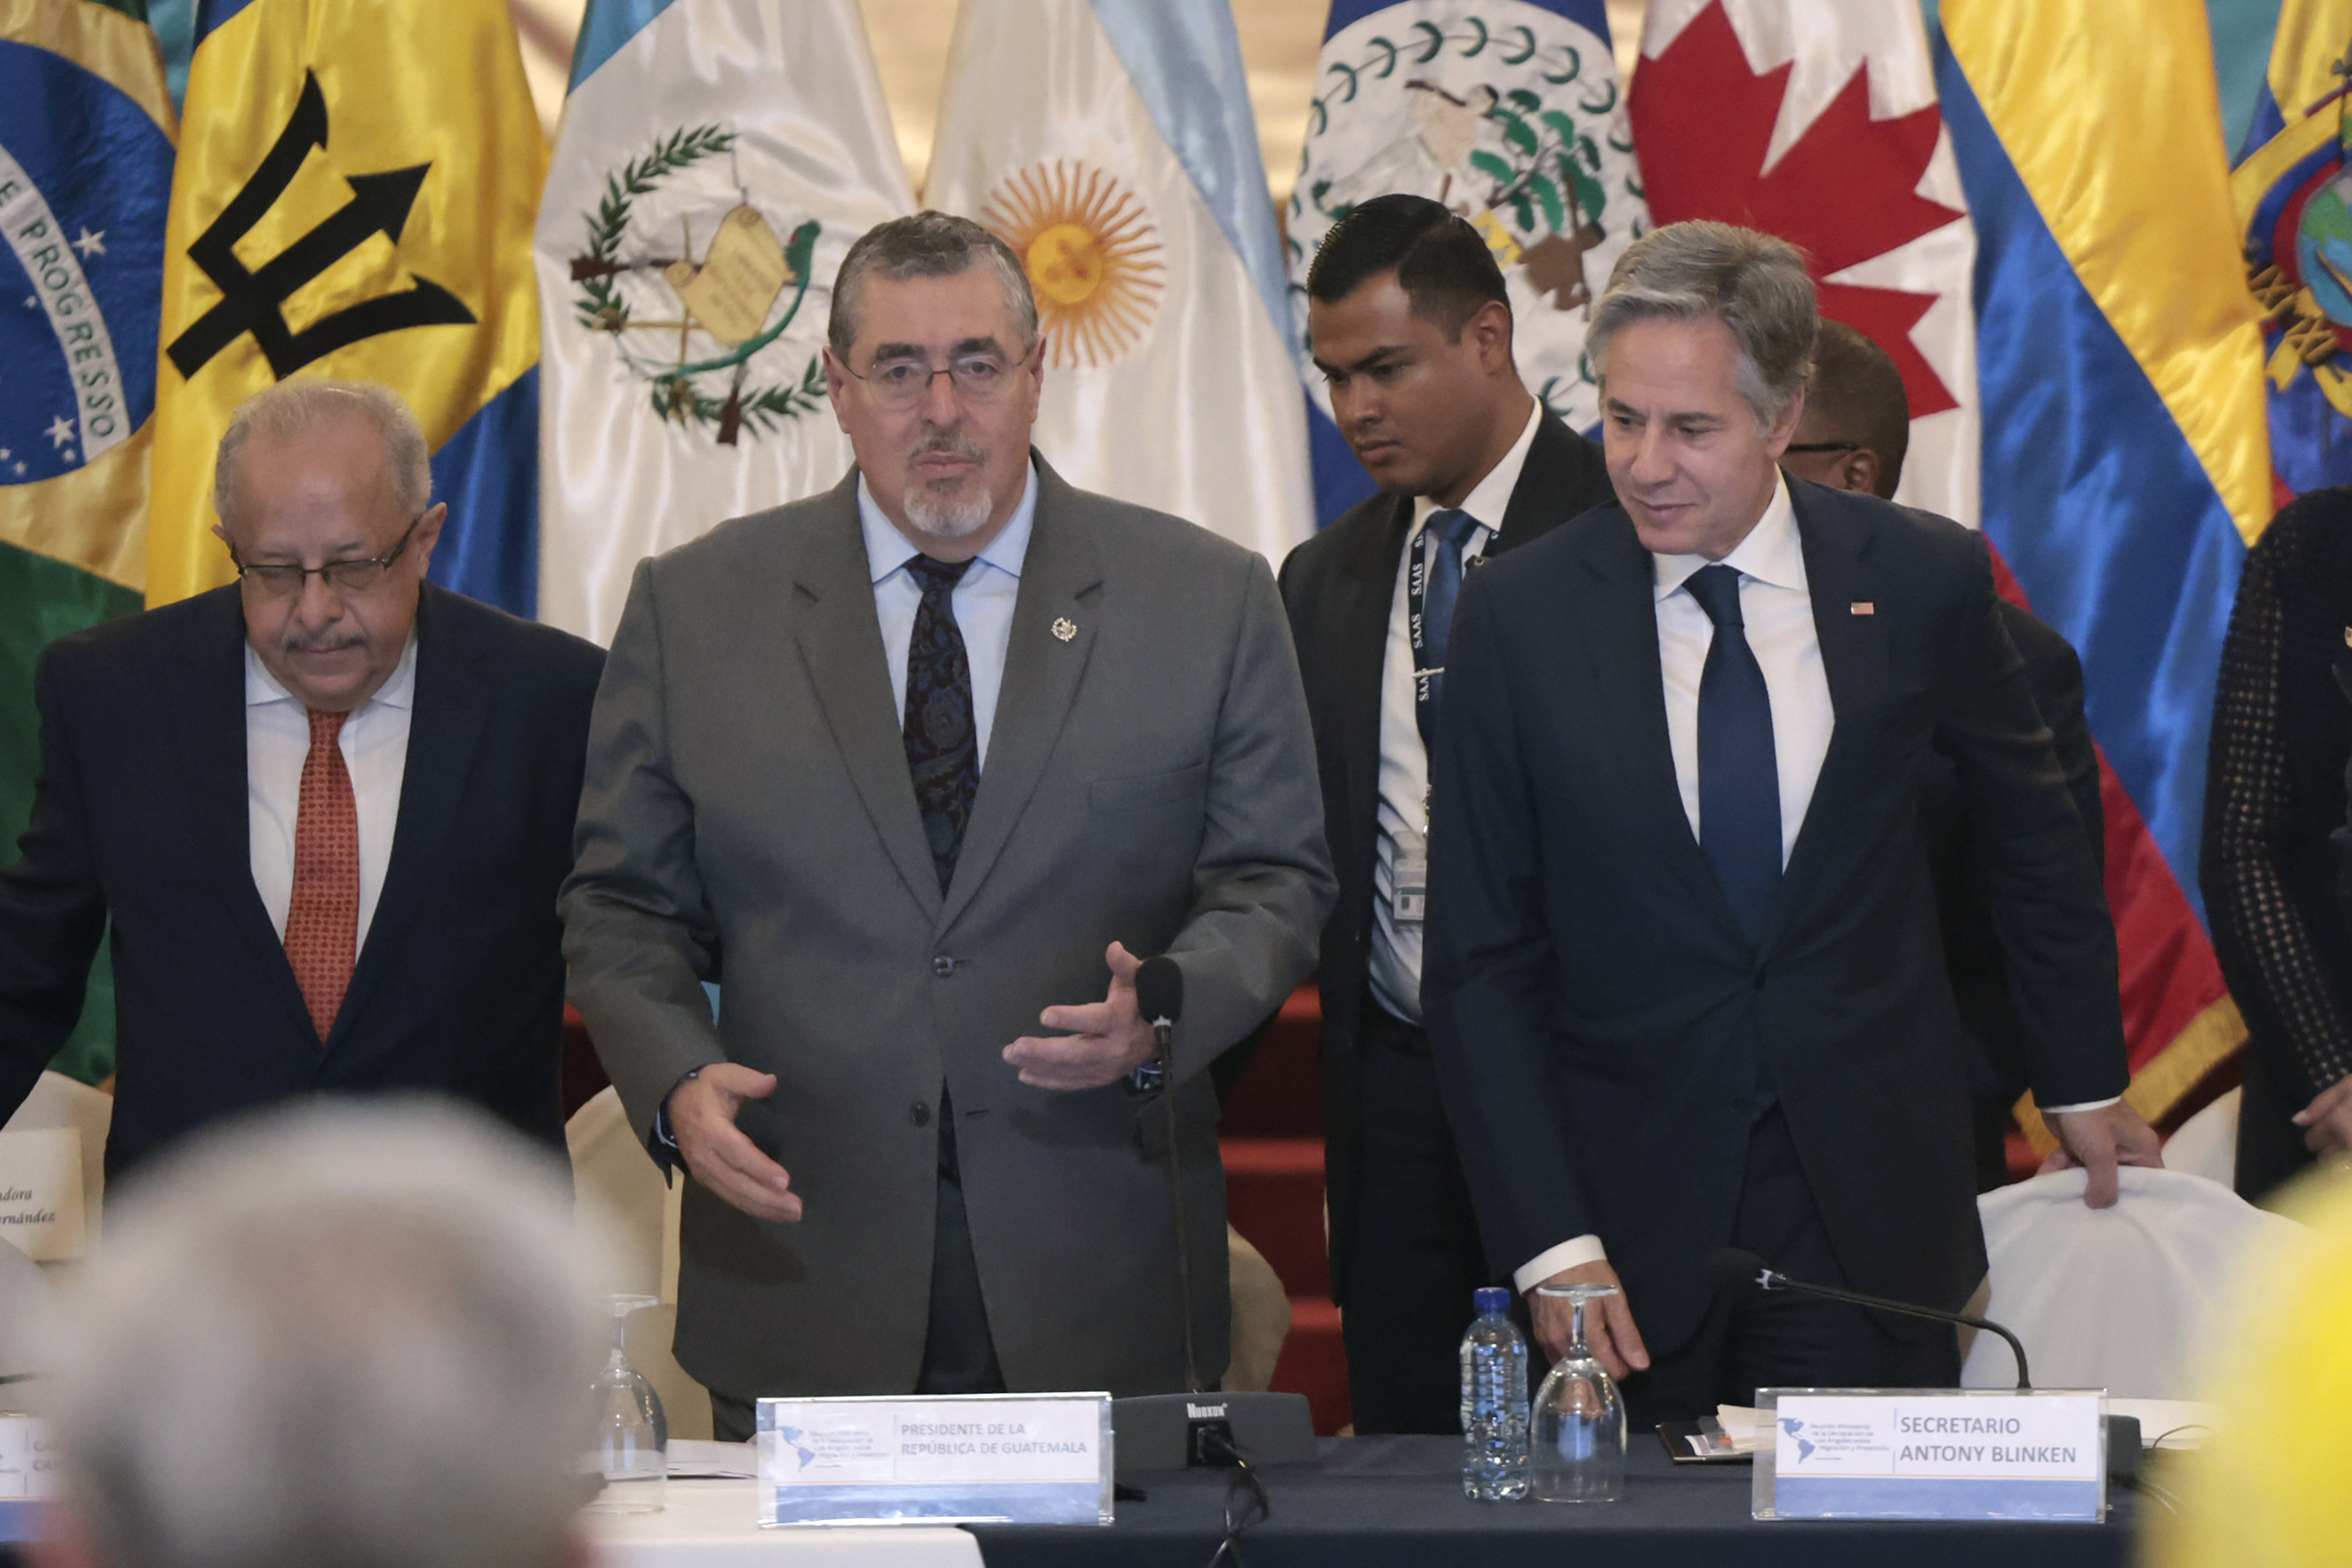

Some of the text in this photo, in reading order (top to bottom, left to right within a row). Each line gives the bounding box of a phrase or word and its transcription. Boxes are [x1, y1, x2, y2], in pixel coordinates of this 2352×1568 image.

[17, 220, 115, 438] PROGRESSO
[1411, 562, 1424, 596] SAAS
[1411, 612, 1424, 649] SAAS
[1418, 667, 1430, 702] SAA
[900, 1422, 1026, 1437] PRESIDENTE DE LA
[1900, 1416, 2021, 1434] SECRETARIO
[900, 1440, 1087, 1456] REPÚBLICA DE GUATEMALA
[1899, 1445, 2077, 1463] ANTONY BLINKEN
